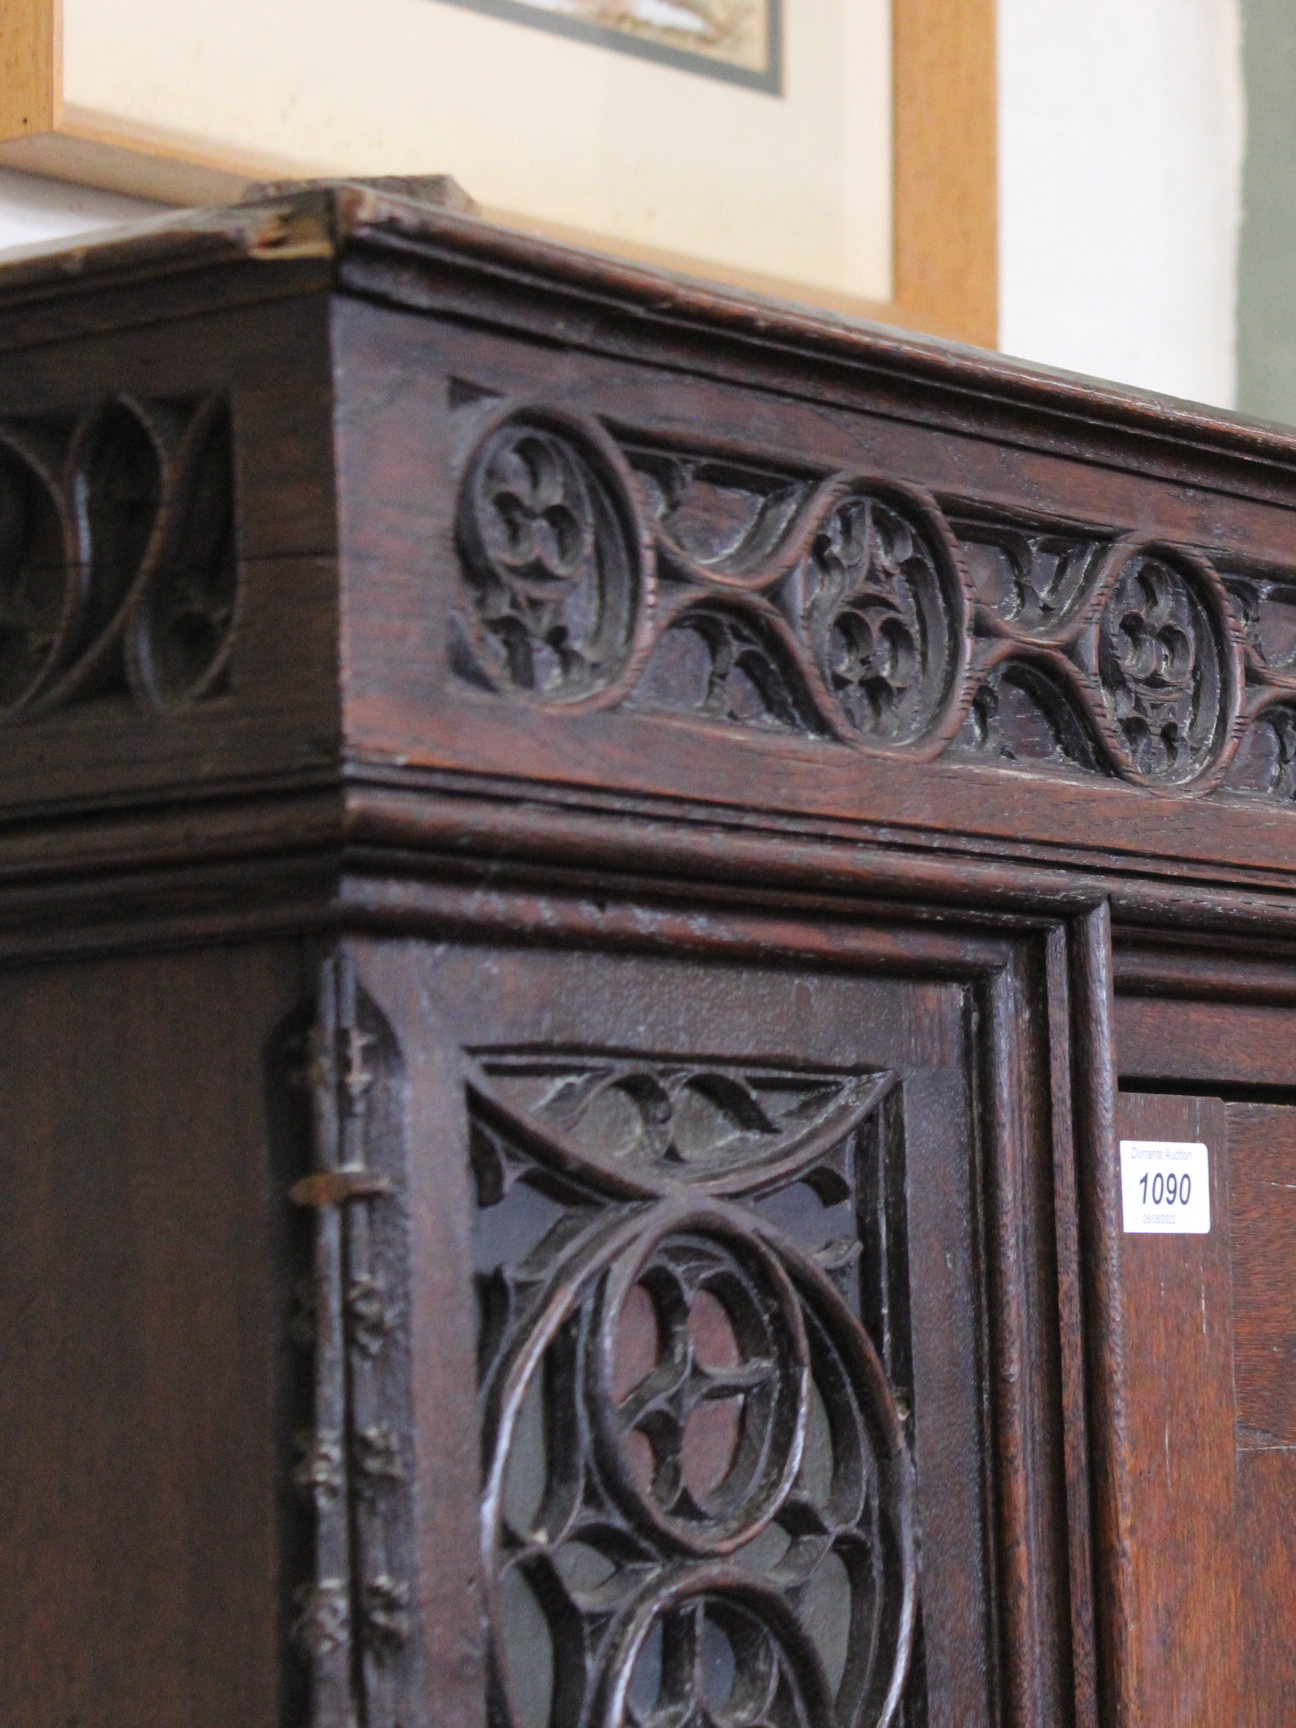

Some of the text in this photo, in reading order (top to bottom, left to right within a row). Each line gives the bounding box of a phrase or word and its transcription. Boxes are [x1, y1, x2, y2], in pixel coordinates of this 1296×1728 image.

[1131, 1147, 1193, 1161] Durrants Auction
[1139, 1172, 1192, 1206] 1090
